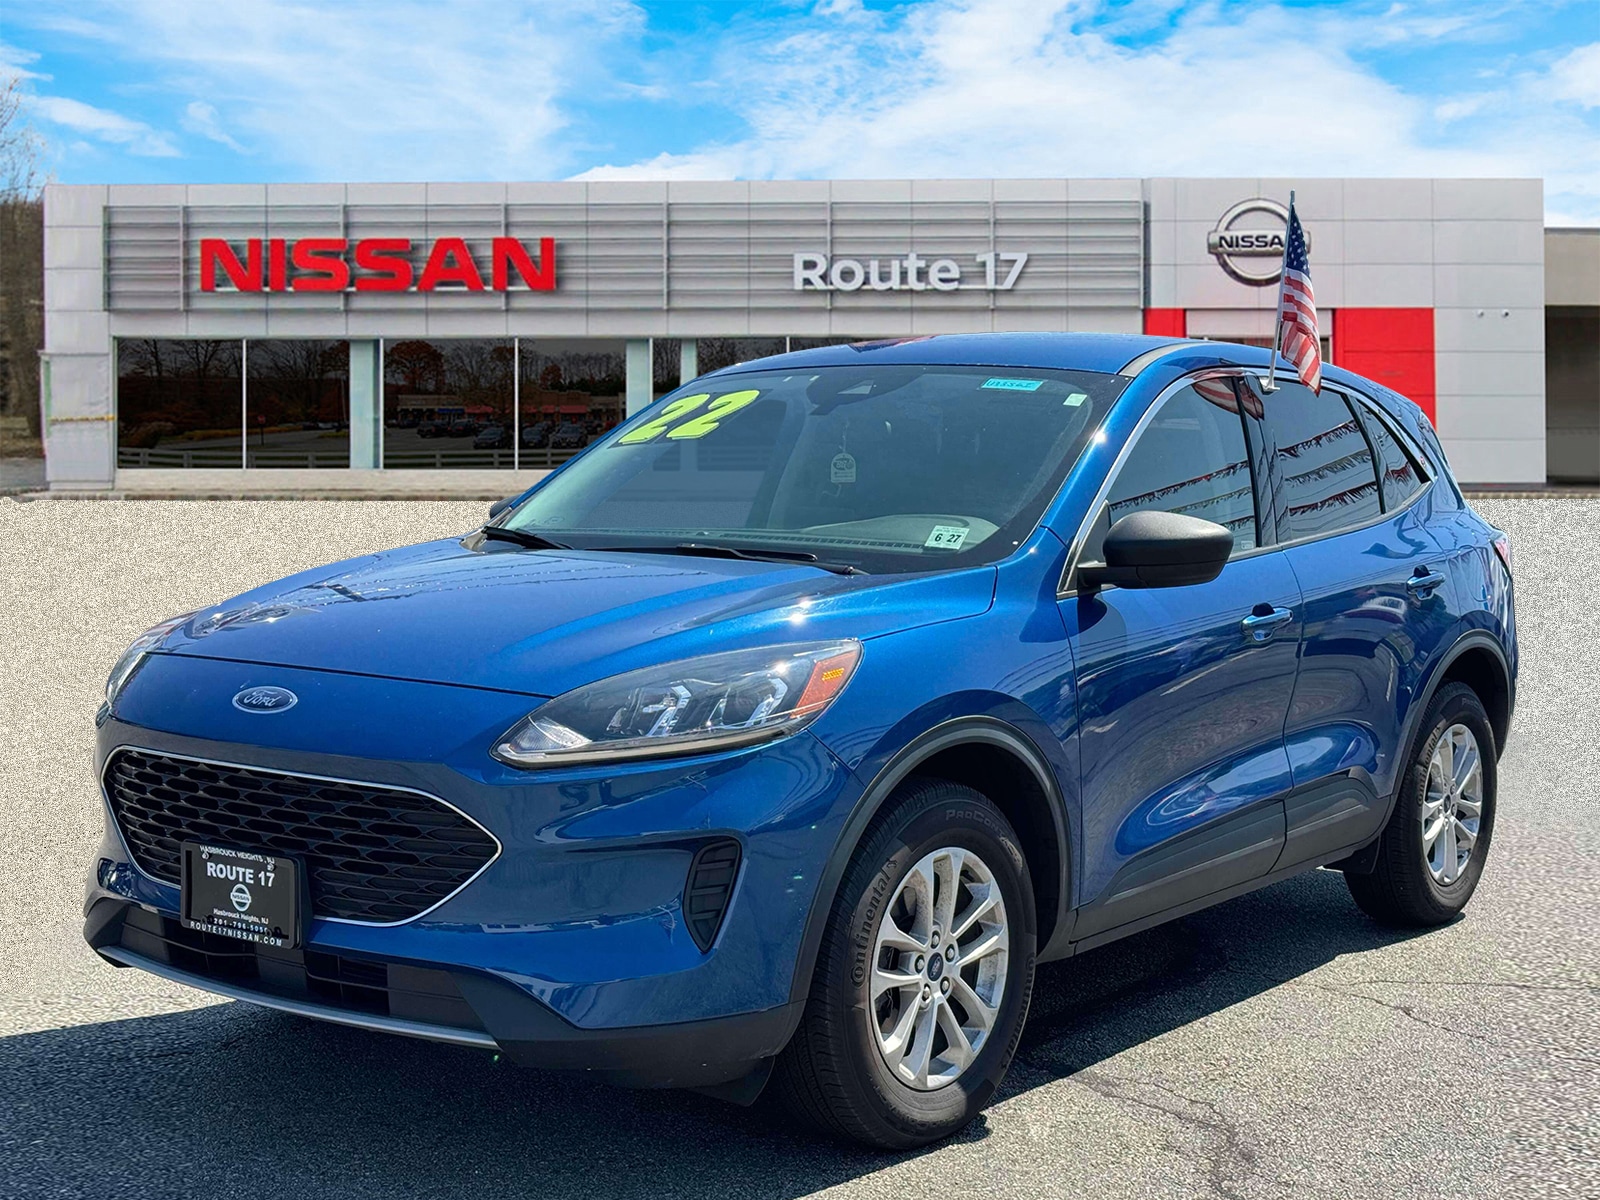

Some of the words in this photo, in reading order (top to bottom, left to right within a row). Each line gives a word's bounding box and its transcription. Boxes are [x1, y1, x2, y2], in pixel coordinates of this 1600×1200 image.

[1218, 234, 1285, 249] NISSA
[200, 237, 556, 292] NISSAN
[793, 251, 960, 292] Route
[975, 251, 1028, 290] 17
[618, 389, 760, 445] 22
[934, 533, 943, 542] 6
[946, 533, 962, 543] 27
[243, 689, 282, 707] Ford
[206, 861, 254, 884] ROUTE
[258, 870, 275, 888] 17
[213, 908, 240, 919] Hasbrouck
[261, 917, 269, 925] NJ
[190, 920, 282, 946] ROUTE17NISSAN.COM
